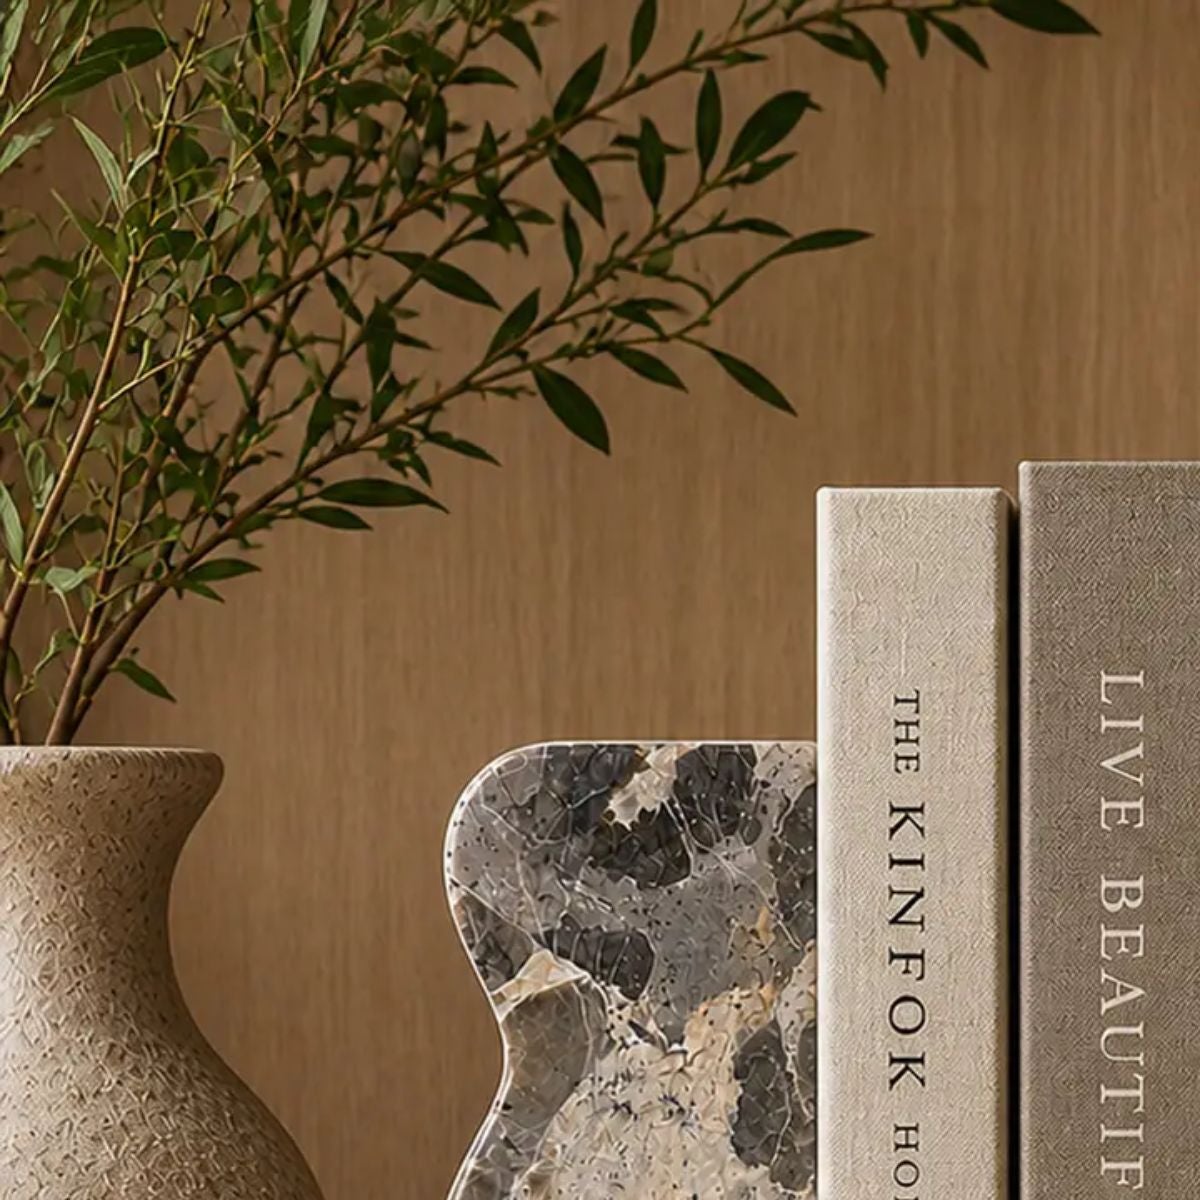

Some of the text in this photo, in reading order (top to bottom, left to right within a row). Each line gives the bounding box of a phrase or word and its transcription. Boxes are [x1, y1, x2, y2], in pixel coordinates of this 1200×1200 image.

[894, 689, 920, 774] THE
[1100, 670, 1144, 831] LIVE
[888, 802, 926, 1090] KINFOK
